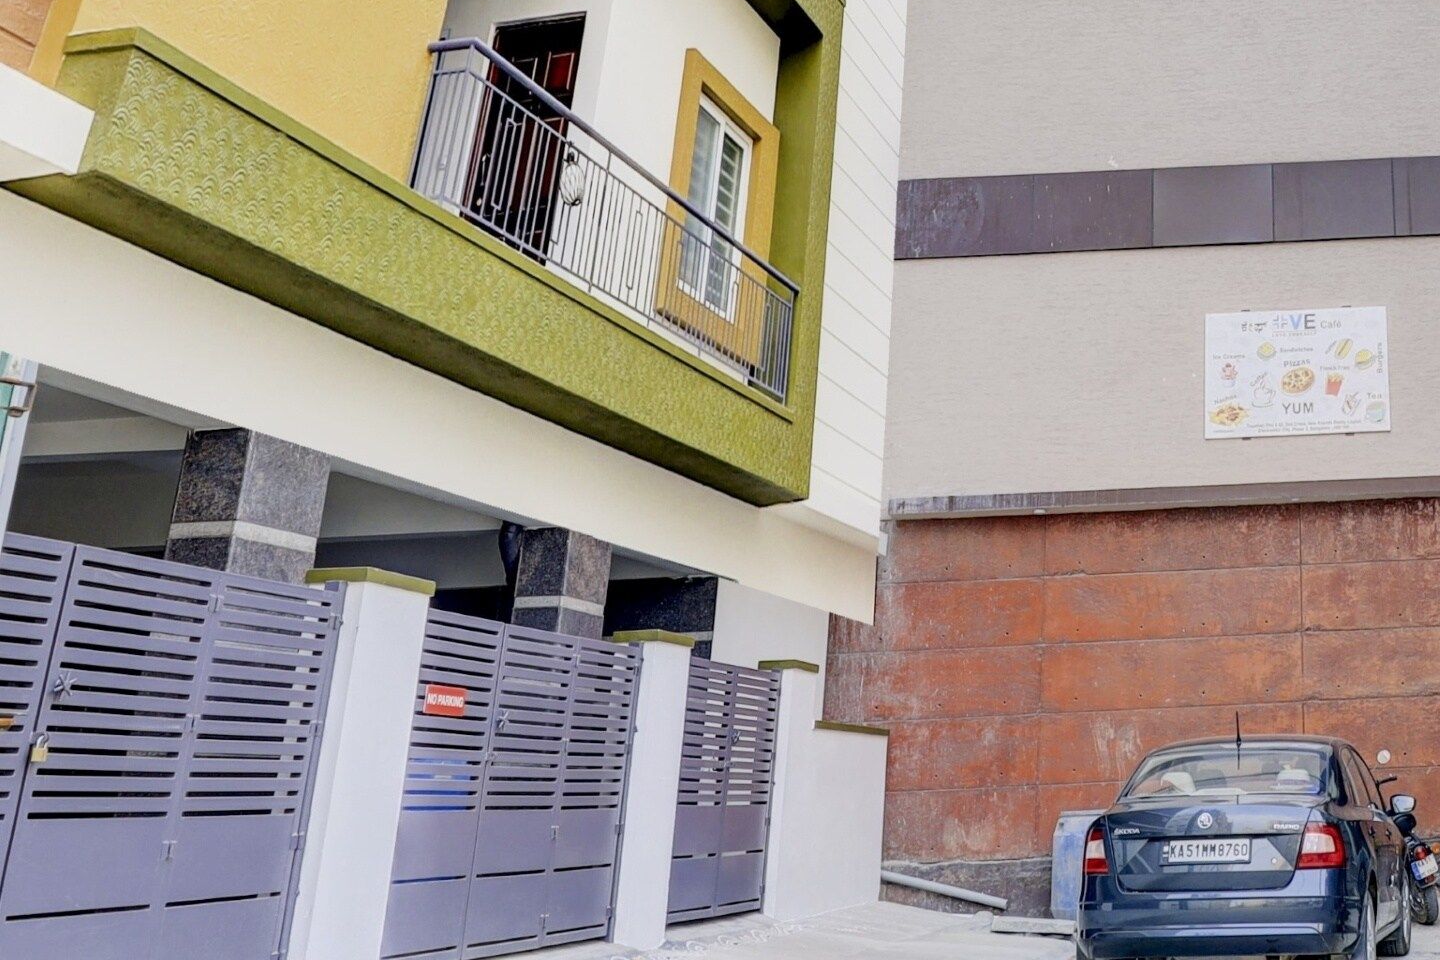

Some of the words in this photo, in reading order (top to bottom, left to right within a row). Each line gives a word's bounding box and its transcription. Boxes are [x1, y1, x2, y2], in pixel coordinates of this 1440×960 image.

[1376, 342, 1384, 374] Burgers
[1282, 402, 1314, 415] YUM
[427, 693, 437, 705] NO
[437, 694, 464, 708] PARKING
[1169, 843, 1248, 858] KA51MM8760
